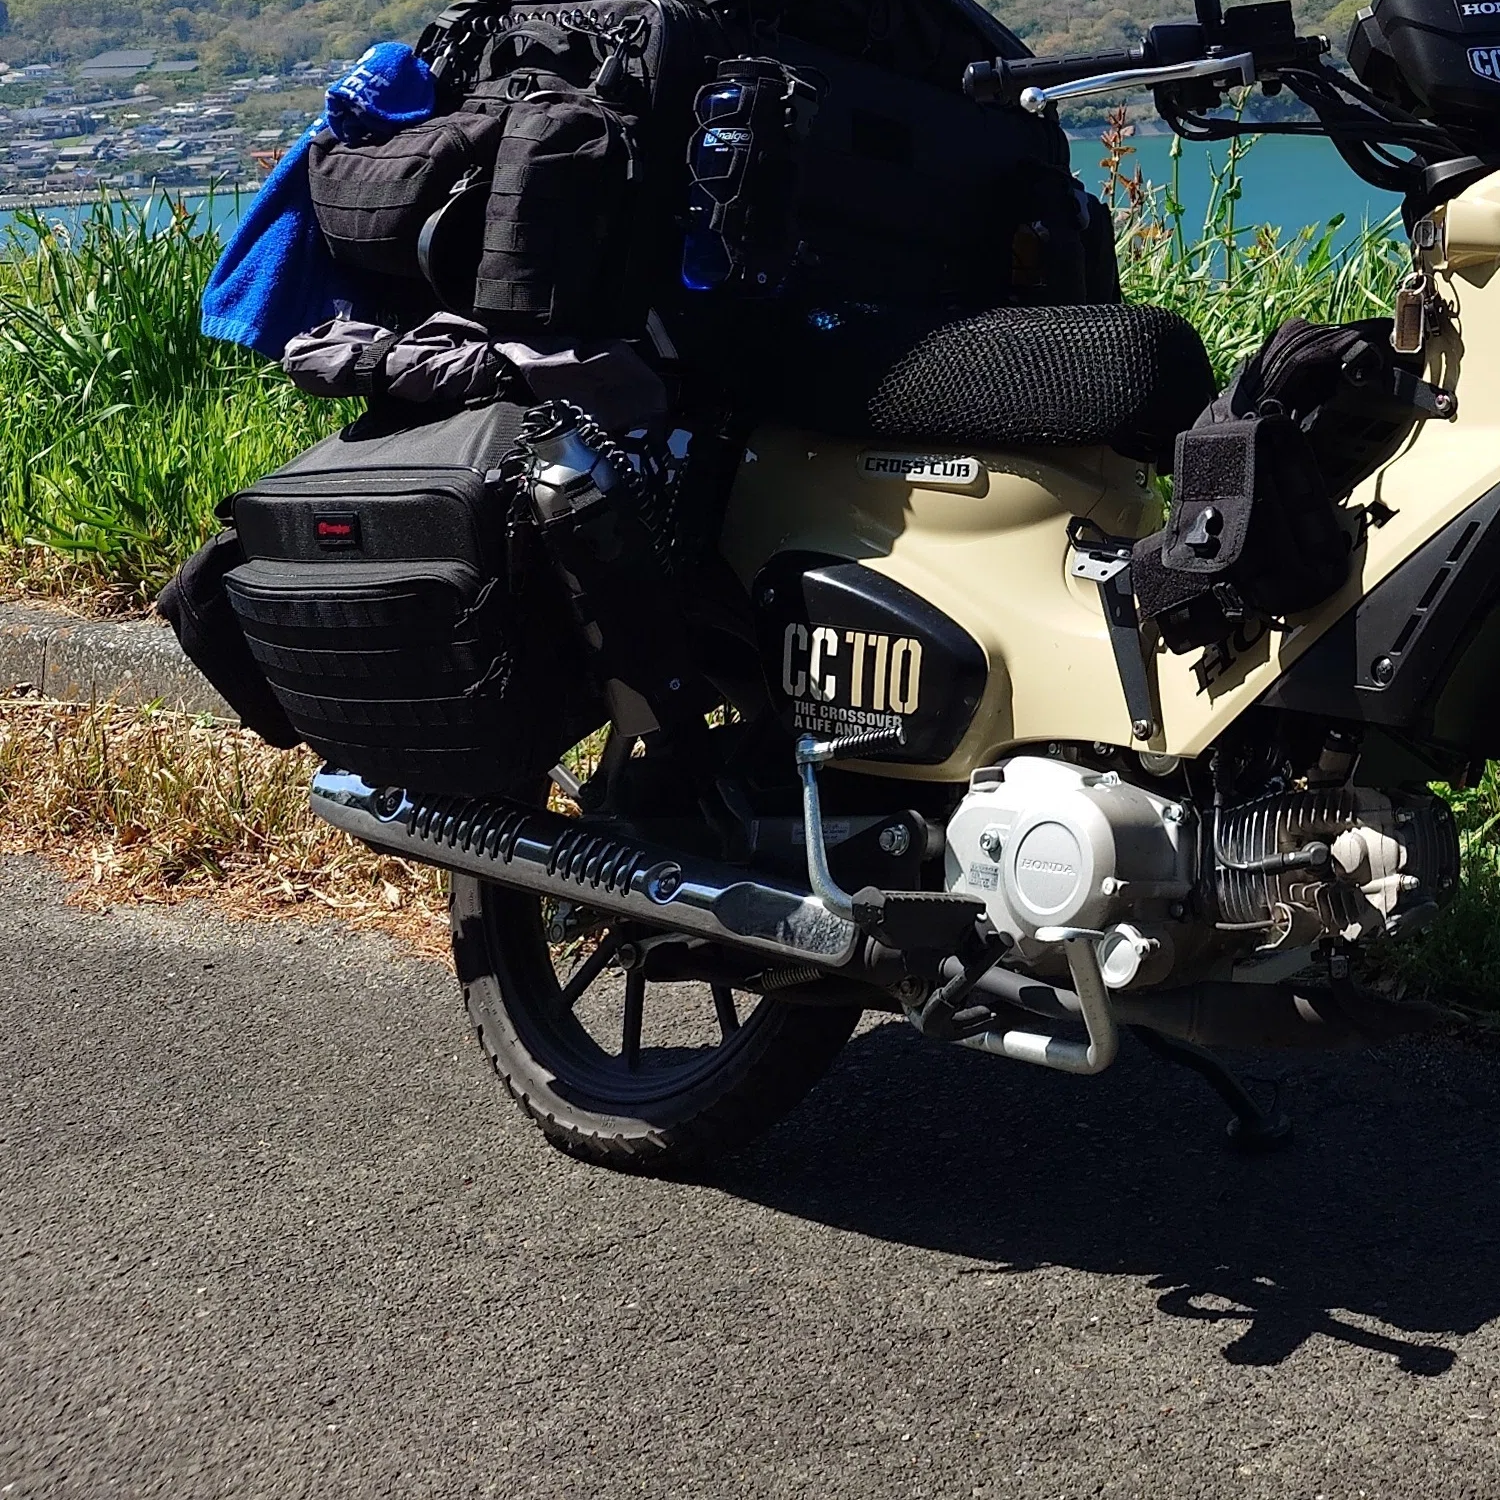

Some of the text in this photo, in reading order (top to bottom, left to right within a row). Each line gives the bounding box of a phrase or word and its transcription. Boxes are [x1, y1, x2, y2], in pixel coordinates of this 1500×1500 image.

[864, 457, 971, 478] CROSS CUB
[793, 700, 903, 729] THE CROSSOVER
[793, 715, 803, 729] A
[805, 717, 832, 734] LIFE
[1020, 858, 1077, 876] HONDA
